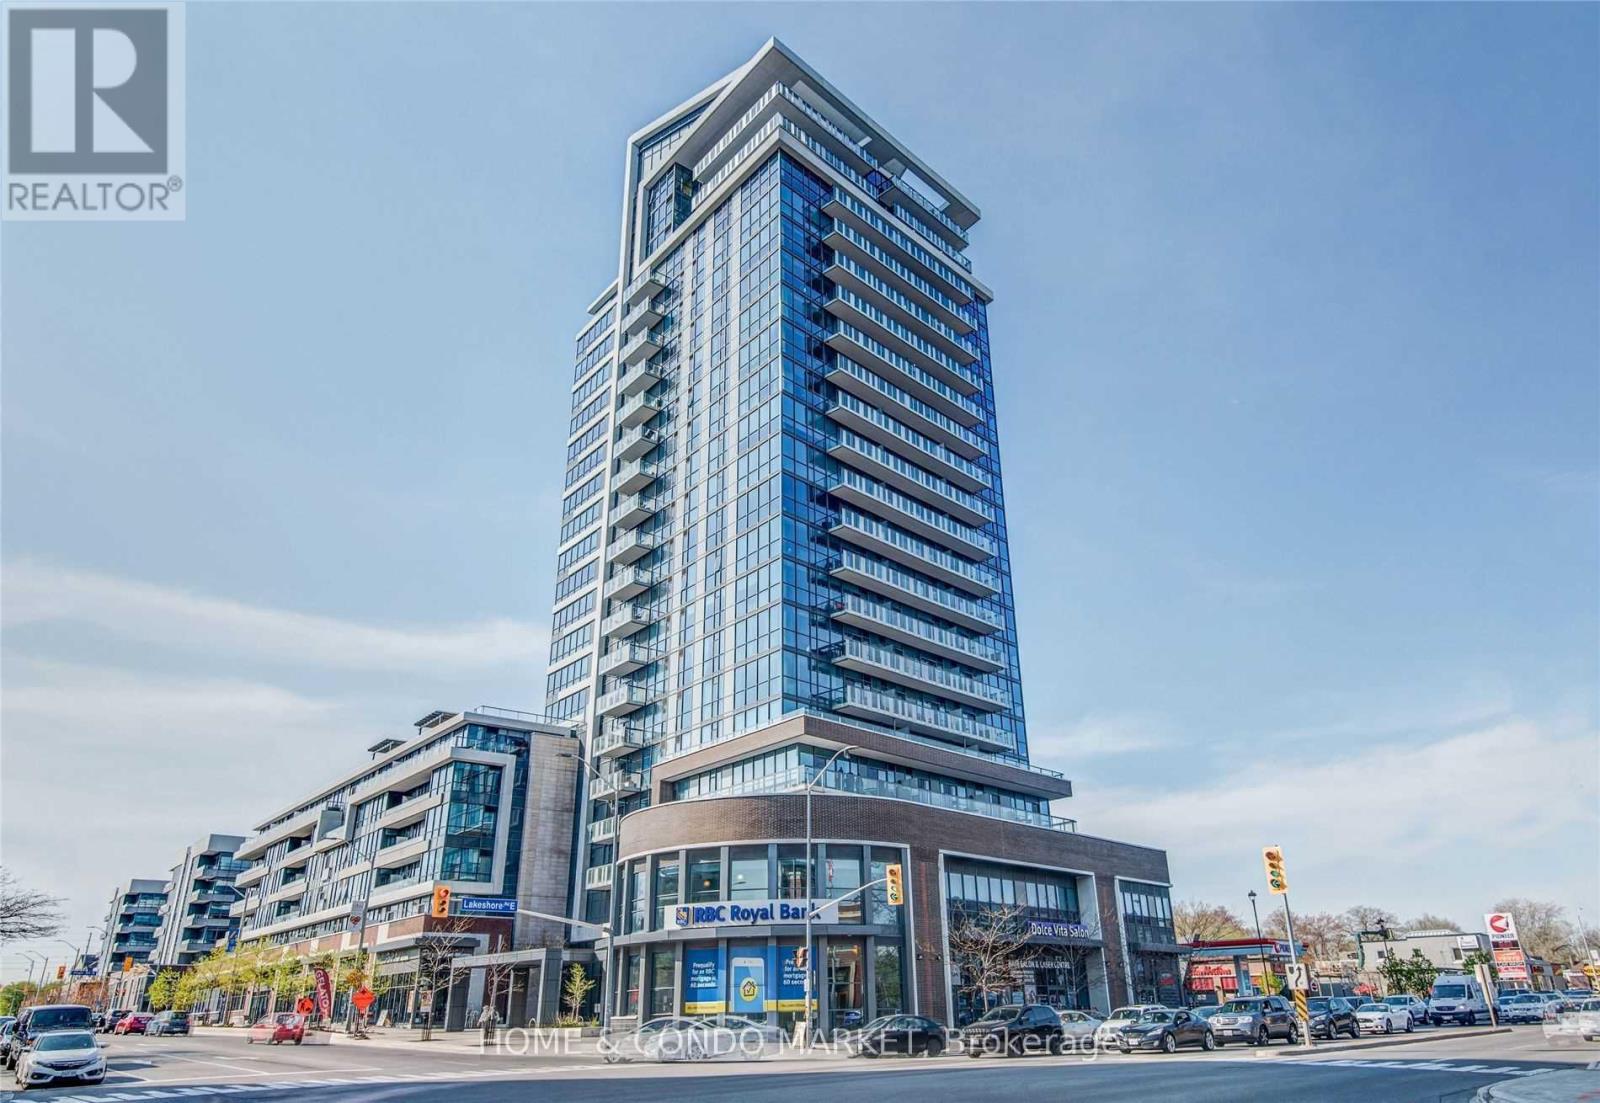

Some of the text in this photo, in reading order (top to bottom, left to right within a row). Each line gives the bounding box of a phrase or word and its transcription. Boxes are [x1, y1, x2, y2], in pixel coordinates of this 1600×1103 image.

[463, 899, 502, 910] Lakeshore
[510, 901, 516, 910] E
[694, 905, 726, 923] RBC
[731, 903, 775, 924] Royal
[1031, 922, 1089, 938] Dolce Vita Salon
[316, 969, 330, 1008] GELATO
